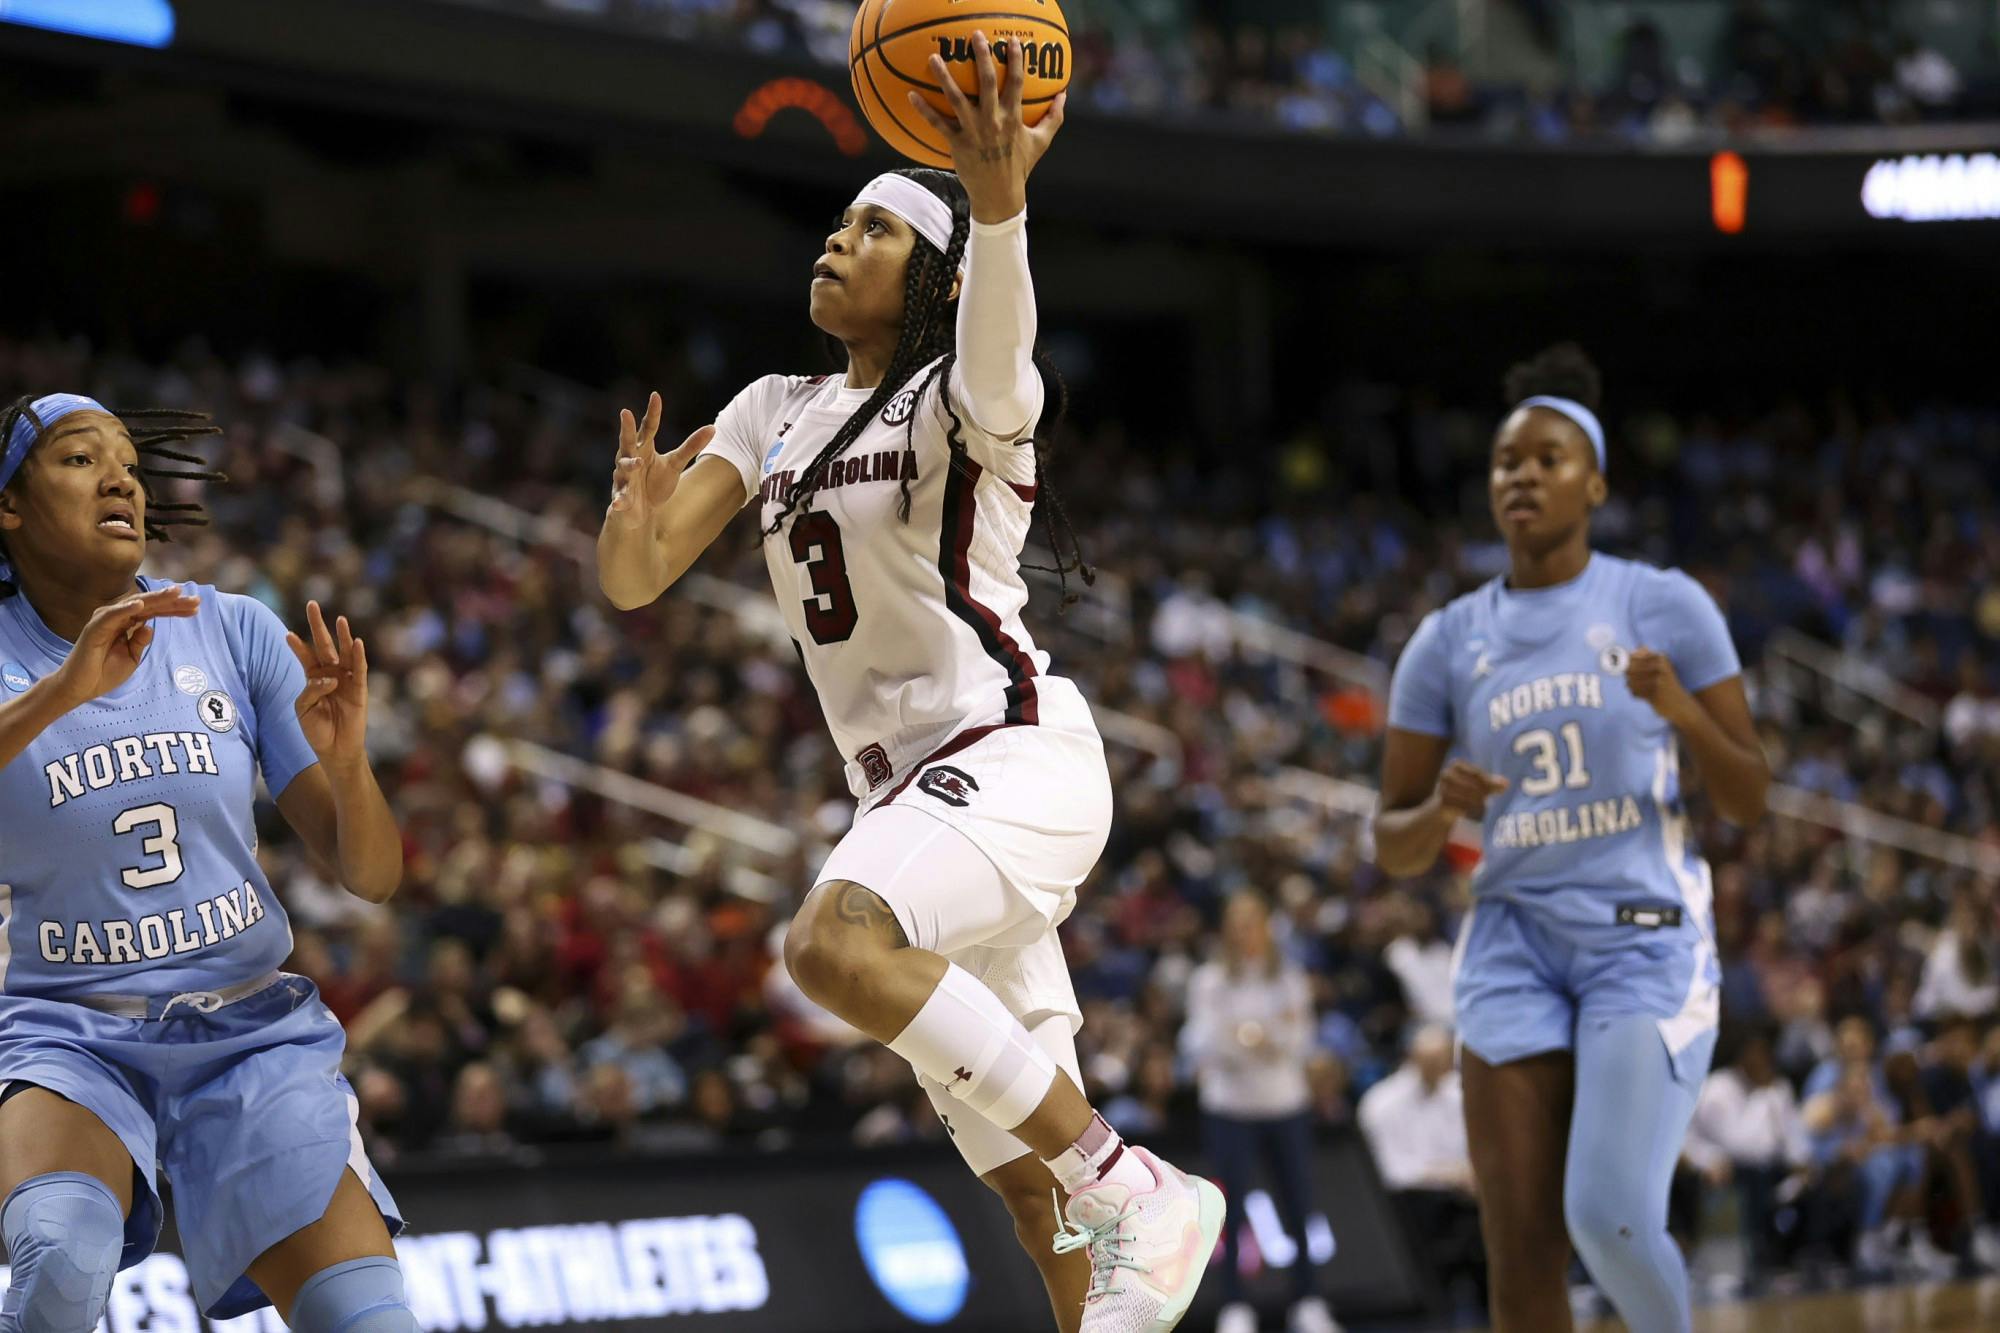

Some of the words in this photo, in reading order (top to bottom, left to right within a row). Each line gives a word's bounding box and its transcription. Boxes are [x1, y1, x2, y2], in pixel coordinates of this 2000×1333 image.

[937, 36, 1064, 80] Wisn
[884, 391, 914, 422] SEC
[811, 450, 919, 493] AROLINA
[789, 510, 859, 646] 3
[1488, 672, 1602, 730] NORTH
[44, 731, 219, 808] NORTH
[1512, 722, 1590, 796] 31
[112, 801, 185, 889] 3
[38, 880, 265, 965] CAROLINA
